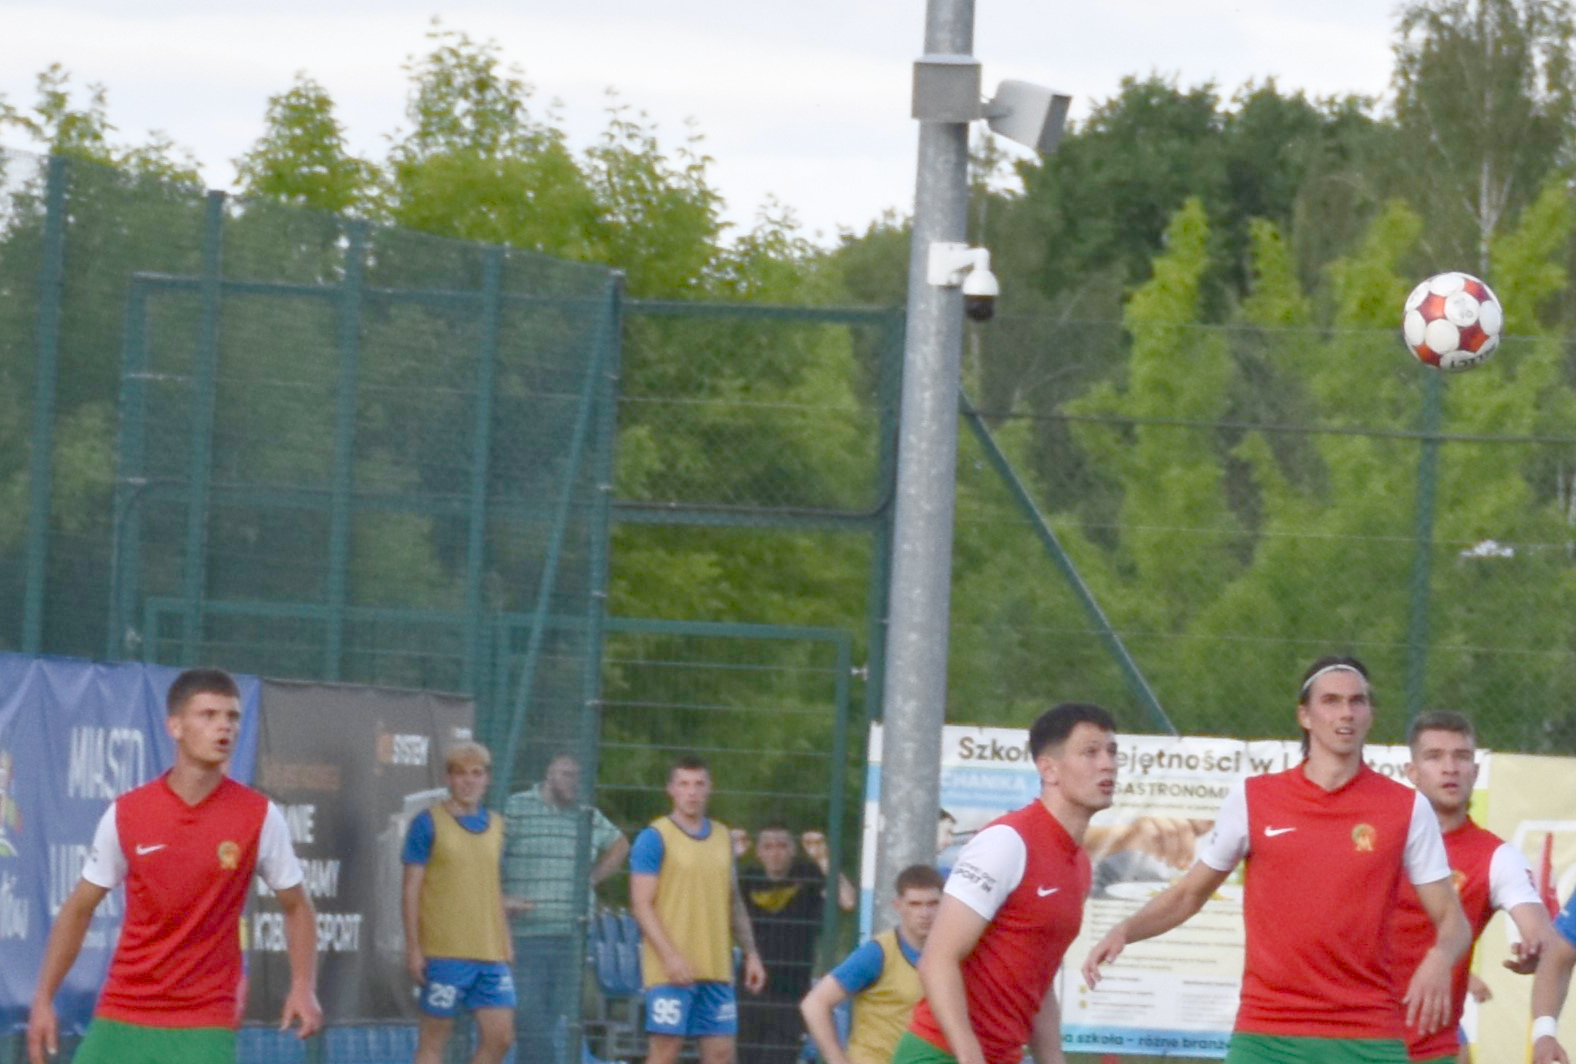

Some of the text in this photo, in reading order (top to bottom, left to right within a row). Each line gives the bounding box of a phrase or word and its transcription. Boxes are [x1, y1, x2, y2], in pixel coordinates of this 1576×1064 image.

[1116, 741, 1242, 774] ejętności
[1249, 758, 1274, 773] w
[427, 983, 456, 1008] 29
[650, 998, 682, 1026] 95
